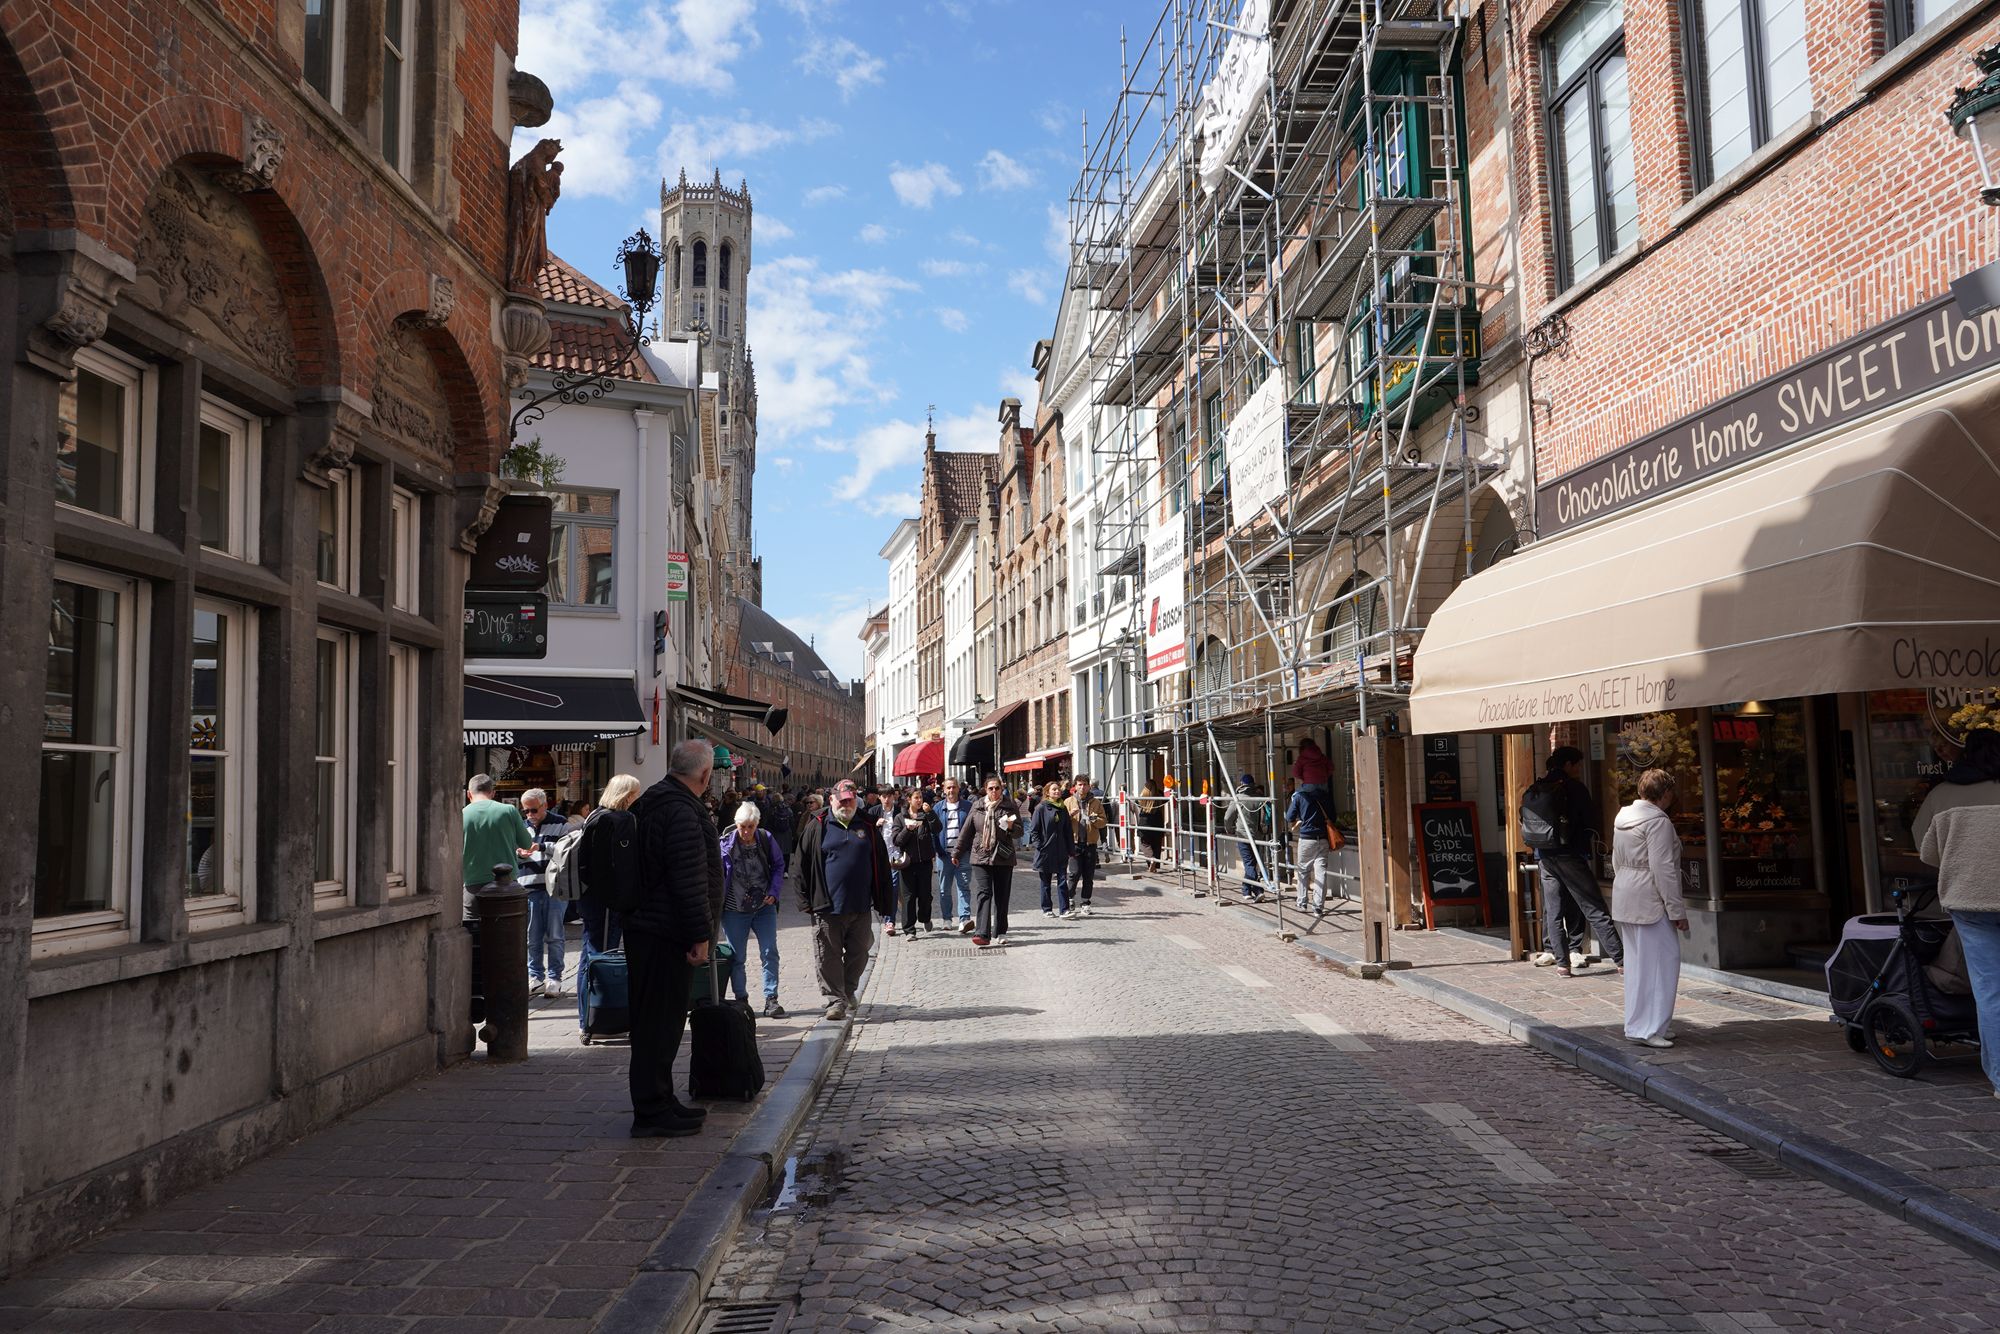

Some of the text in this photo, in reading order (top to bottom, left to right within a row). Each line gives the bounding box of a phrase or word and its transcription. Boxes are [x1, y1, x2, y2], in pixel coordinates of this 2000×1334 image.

[1557, 444, 1683, 523] Chocolaterie
[1691, 412, 1763, 470] Home
[1777, 331, 1907, 432] SWEET
[1162, 604, 1183, 630] BOSCH
[1478, 673, 1677, 723] Chocolaterie Home SWEET Home
[1916, 760, 1944, 775] finest
[1424, 818, 1473, 838] CANAL
[1428, 852, 1474, 863] TERRACE
[1757, 862, 1777, 873] finest
[1735, 875, 1801, 889] Belgian chocolates
